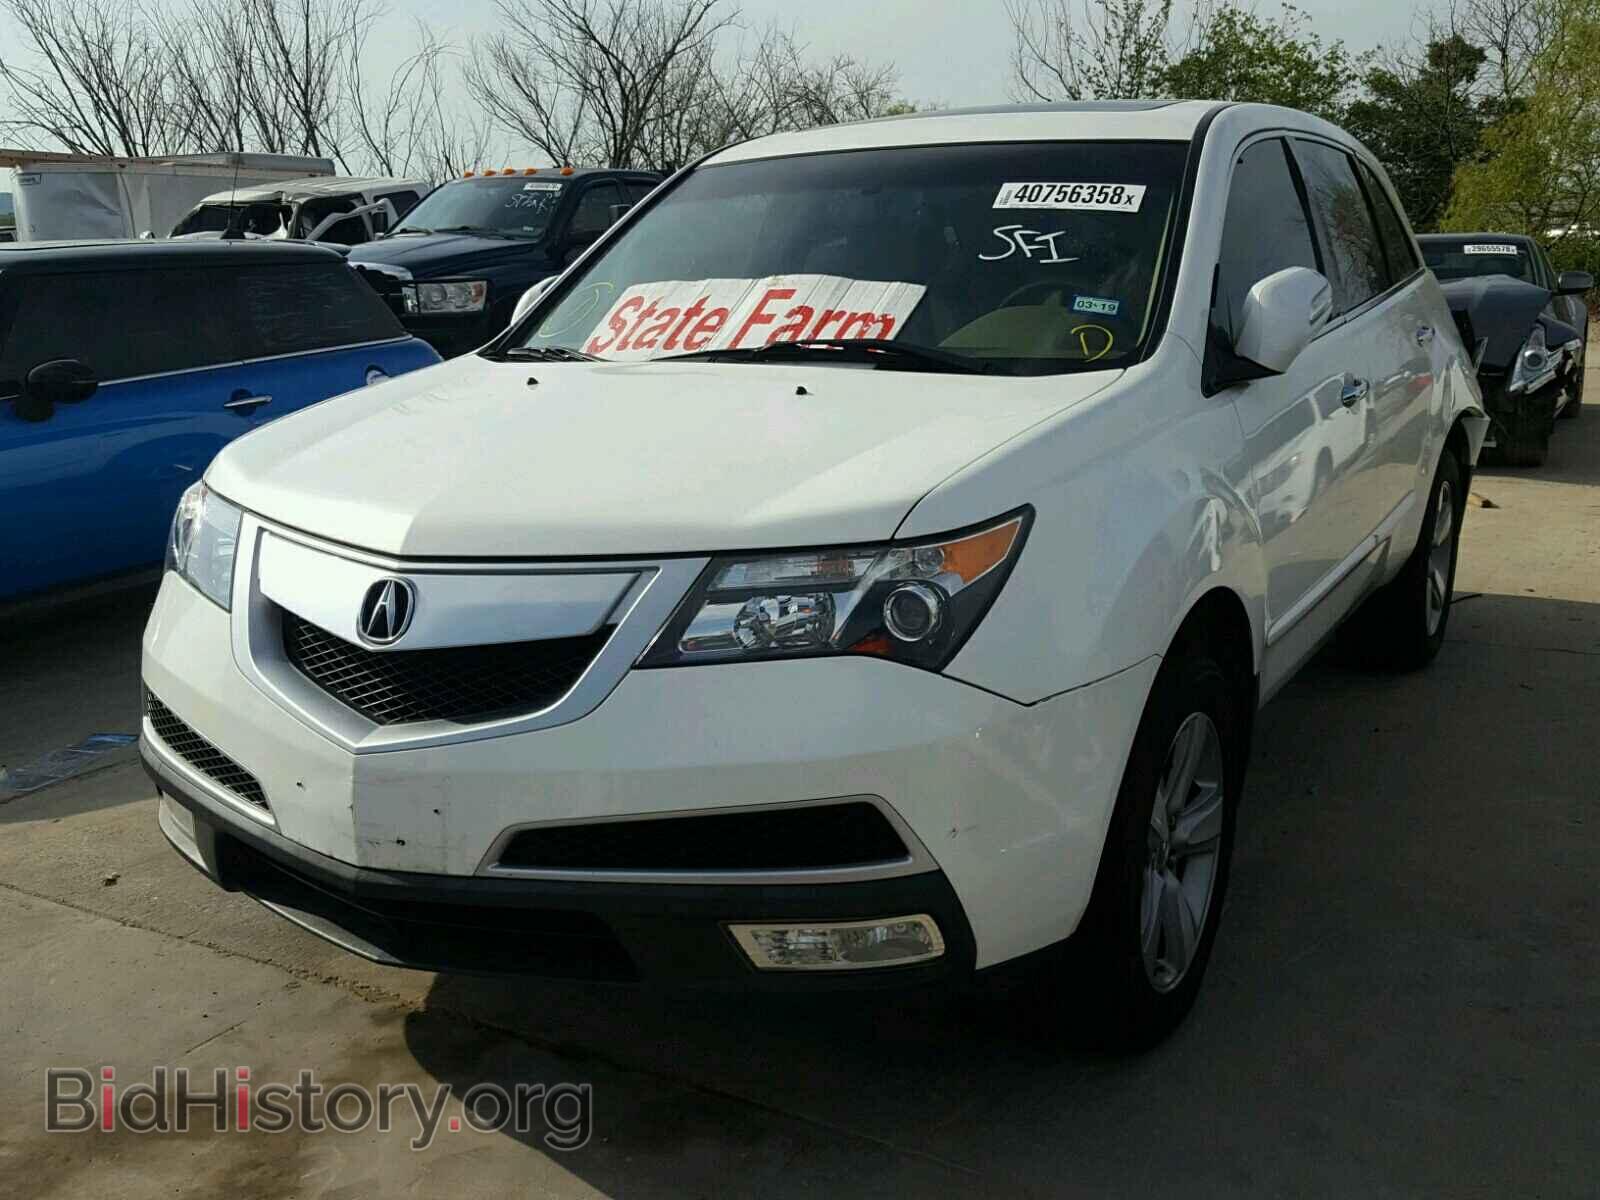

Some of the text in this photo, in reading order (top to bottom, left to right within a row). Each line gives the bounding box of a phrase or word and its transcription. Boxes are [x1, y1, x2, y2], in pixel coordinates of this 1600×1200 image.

[979, 225, 1080, 263] SFI
[586, 295, 731, 353] State
[728, 288, 896, 349] Farm
